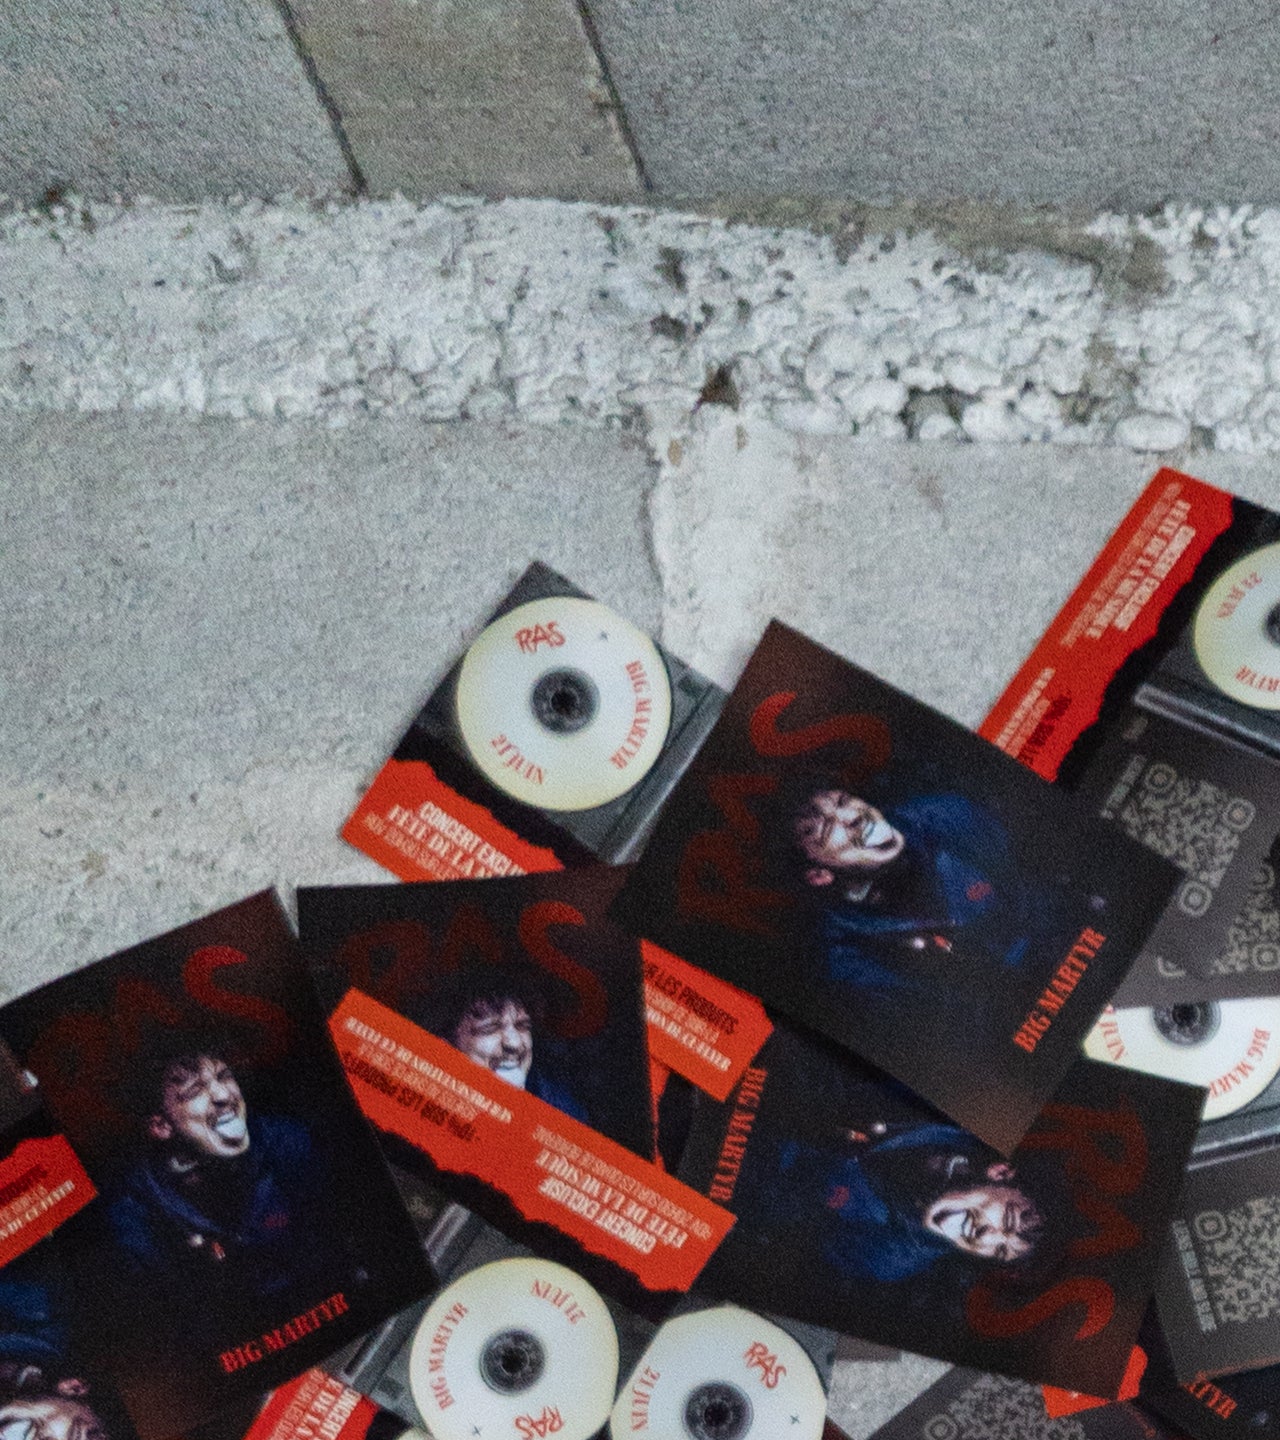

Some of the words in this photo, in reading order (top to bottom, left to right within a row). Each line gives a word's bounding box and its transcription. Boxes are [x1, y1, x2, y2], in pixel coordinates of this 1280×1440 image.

[512, 619, 567, 653] RAS
[624, 659, 647, 692] BIG
[488, 734, 515, 758] 21
[608, 696, 652, 771] MARTYR
[500, 751, 546, 786] JUIN
[1012, 1010, 1054, 1054] BIG
[1042, 923, 1110, 1018] MARTYR
[636, 1366, 660, 1388] 21
[742, 1340, 789, 1390] RAS
[629, 1387, 651, 1433] JUIN
